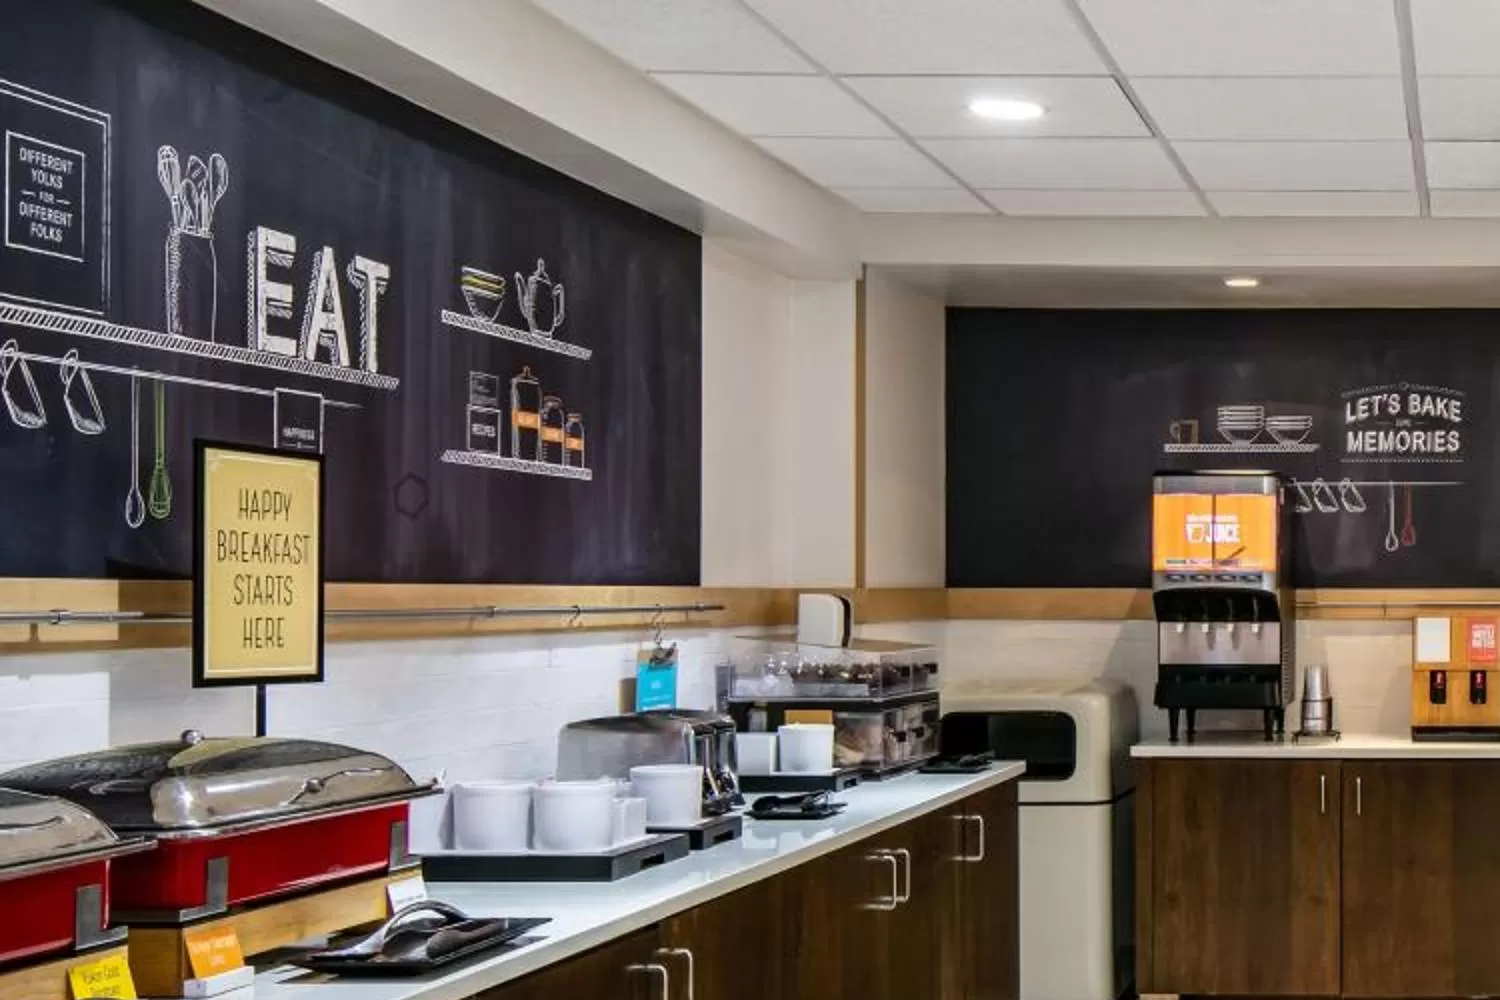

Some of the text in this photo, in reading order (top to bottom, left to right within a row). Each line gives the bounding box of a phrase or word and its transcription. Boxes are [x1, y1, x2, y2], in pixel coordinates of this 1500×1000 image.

[19, 147, 74, 175] DIFFERENT
[31, 168, 63, 189] YOLKS
[19, 201, 73, 228] DIFFERENT
[30, 222, 63, 242] FOLKS
[247, 225, 391, 373] EAT
[1345, 393, 1462, 424] LET'S BAKE
[1346, 430, 1461, 454] MEMORIES
[238, 488, 293, 522] HAPPY
[217, 529, 312, 565] BREAKFAST
[233, 573, 294, 607] STARTS
[242, 617, 286, 650] HERE
